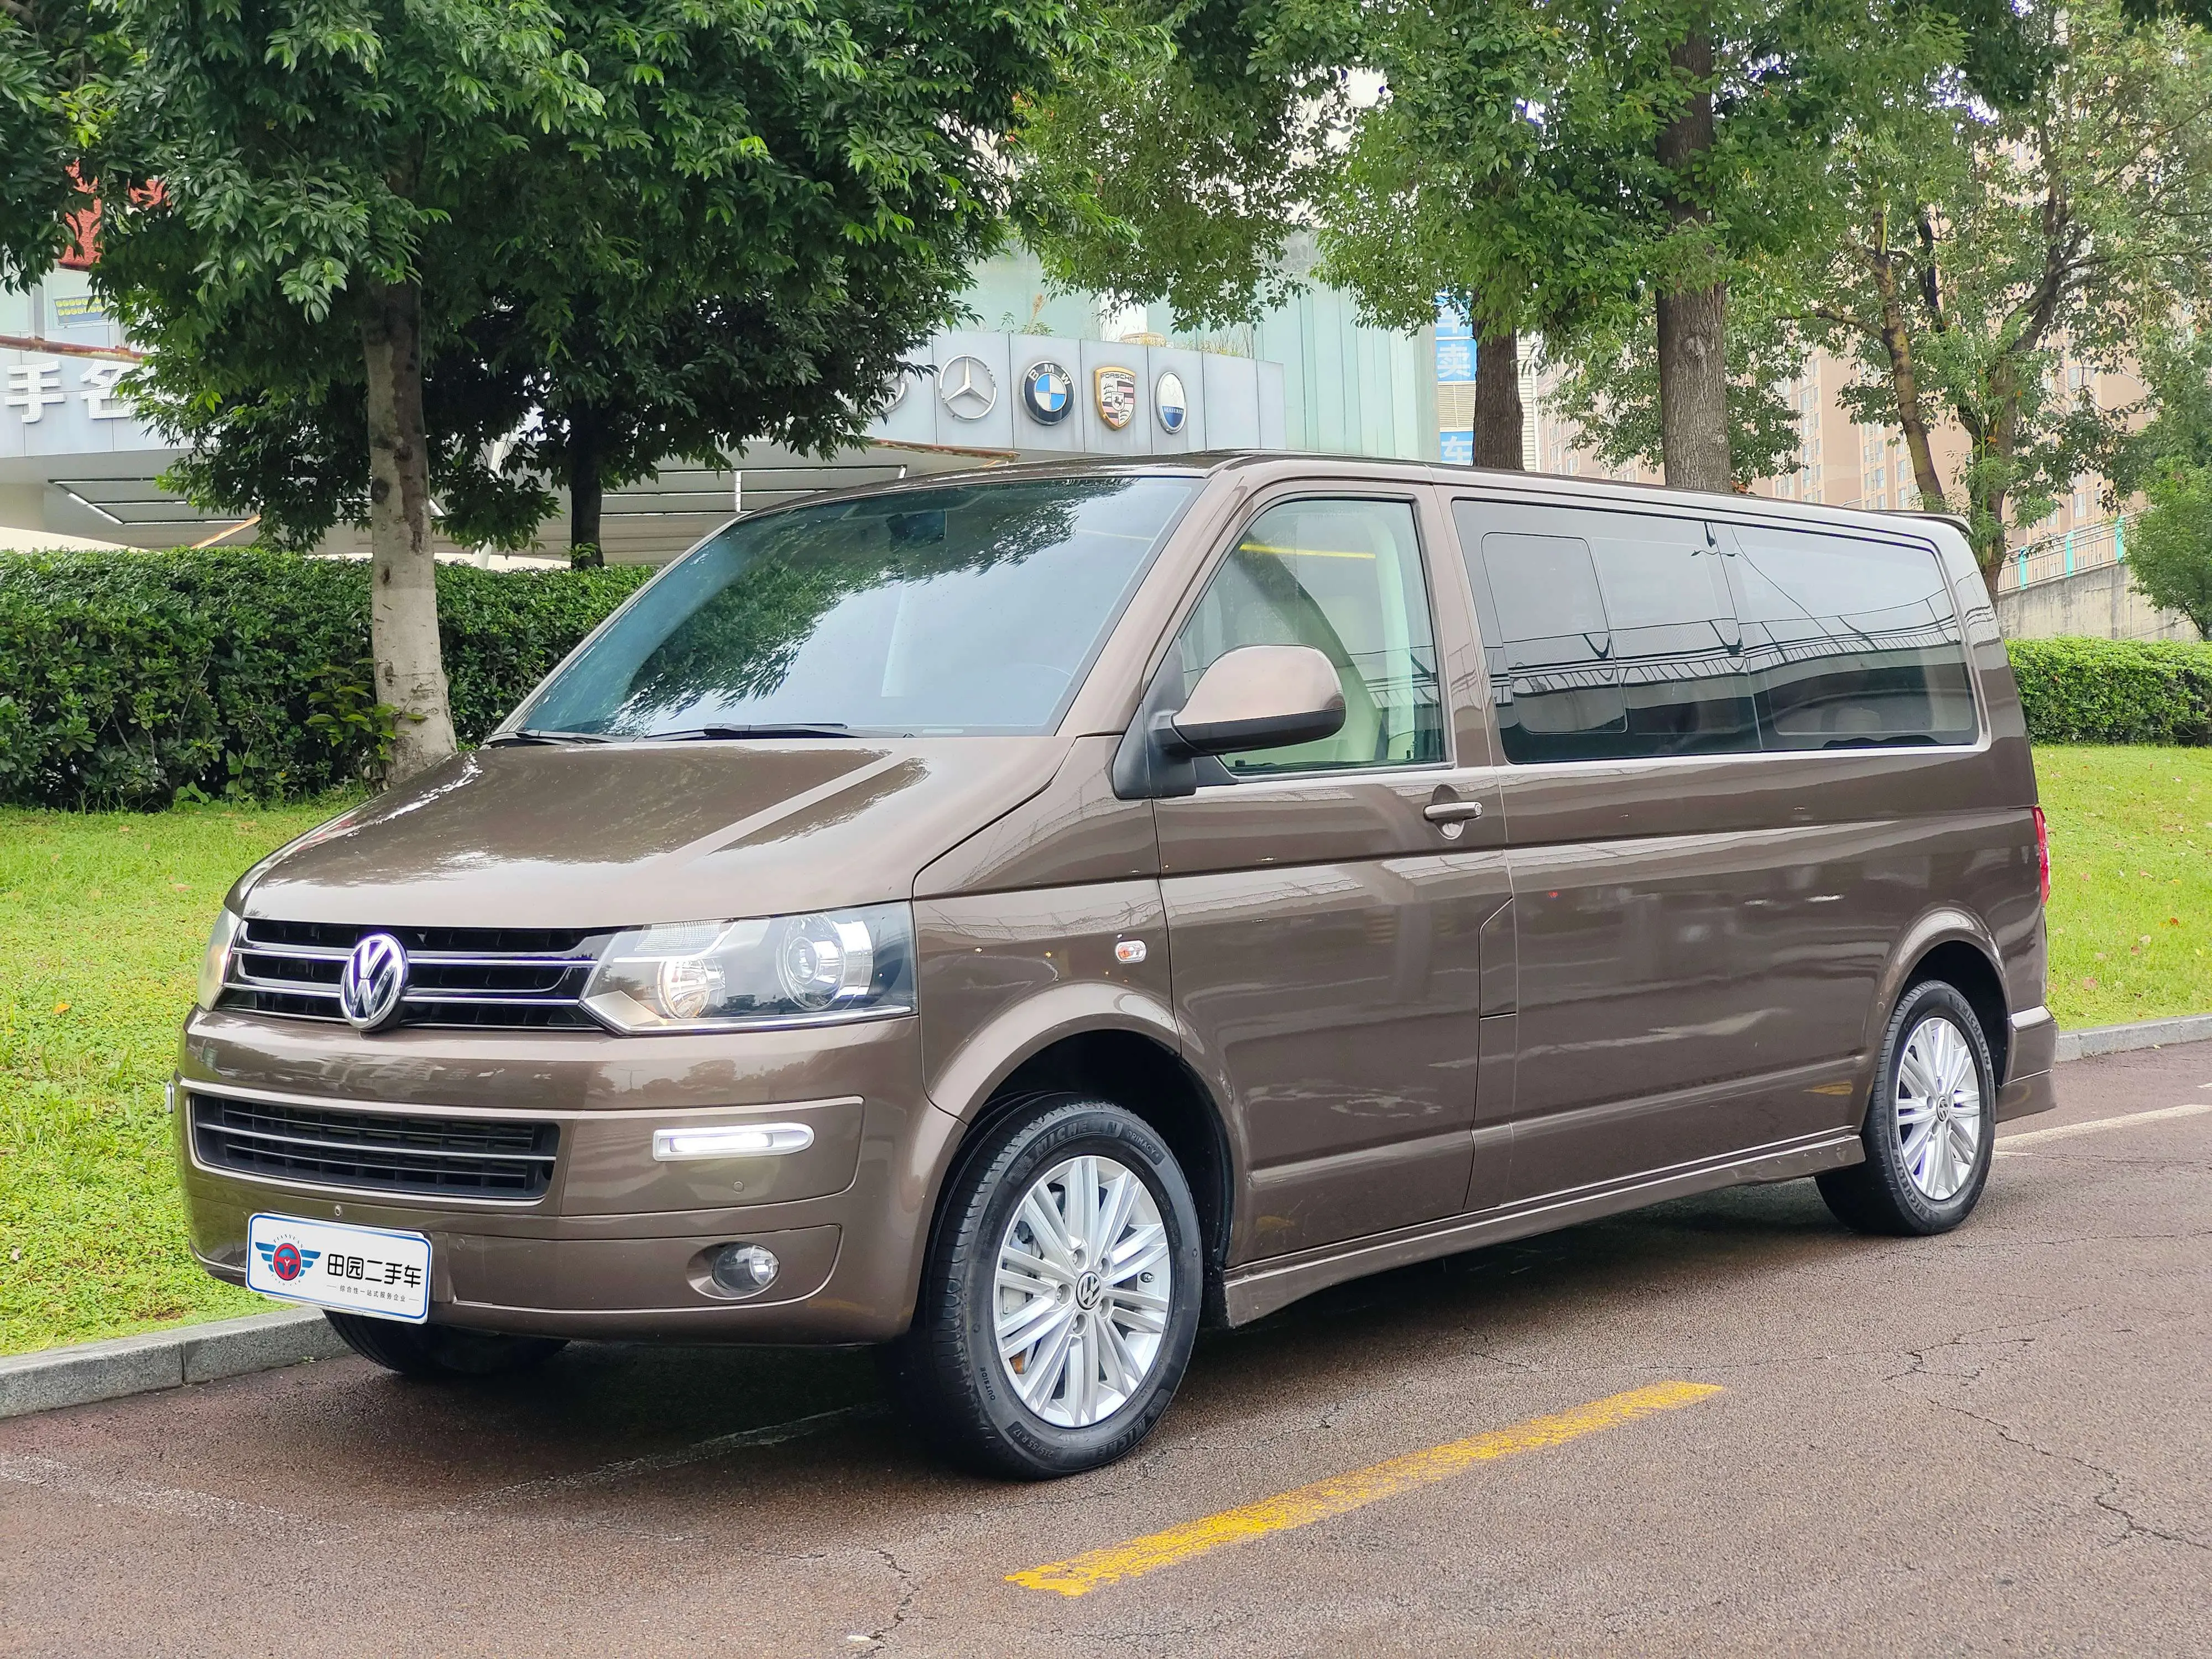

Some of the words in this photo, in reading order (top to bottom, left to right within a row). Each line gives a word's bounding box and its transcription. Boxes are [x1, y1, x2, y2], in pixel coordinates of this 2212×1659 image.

[1028, 363, 1071, 385] BMW
[1100, 373, 1134, 383] PORSCHE
[327, 1253, 422, 1288] 田园二手车
[340, 1285, 406, 1302] 综合性一站式服务企业
[979, 1366, 996, 1401] OUTSIDE
